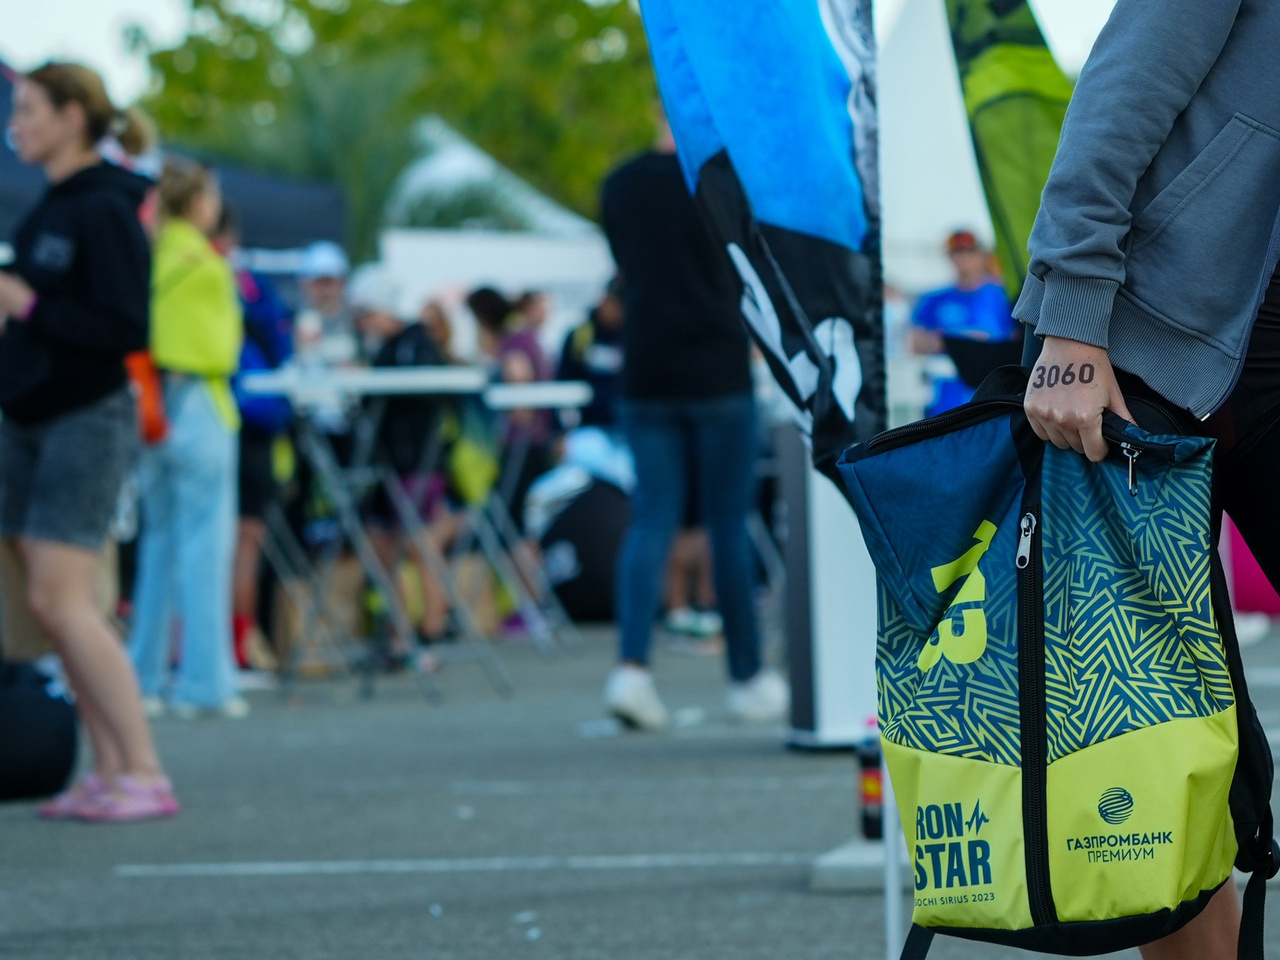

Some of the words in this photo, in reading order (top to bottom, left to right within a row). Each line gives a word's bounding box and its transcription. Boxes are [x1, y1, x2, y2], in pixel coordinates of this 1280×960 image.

[1033, 363, 1095, 389] 3060
[1066, 831, 1173, 851] ГАЗПРОМБАНК
[914, 839, 992, 891] STAR
[1087, 847, 1154, 863] ПРЕМИУМ
[940, 895, 969, 905] SIRIUS
[972, 892, 995, 903] 2023
